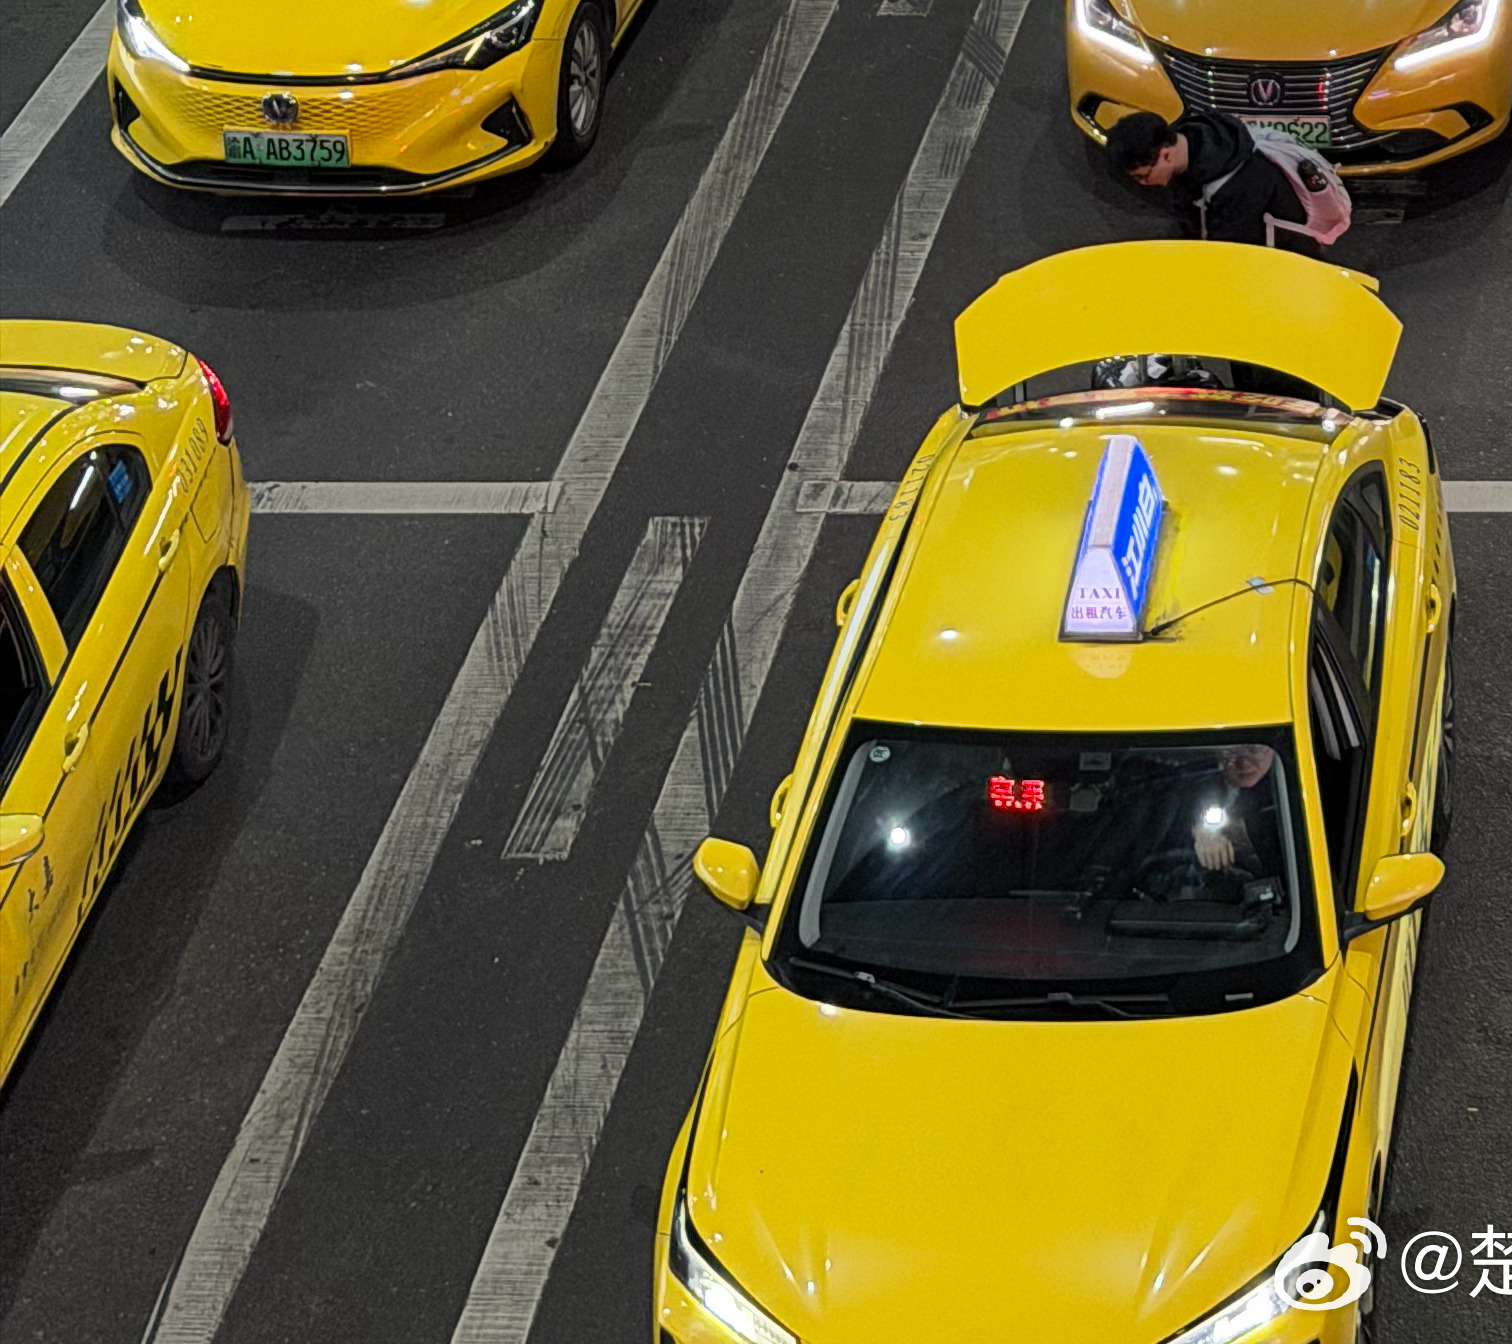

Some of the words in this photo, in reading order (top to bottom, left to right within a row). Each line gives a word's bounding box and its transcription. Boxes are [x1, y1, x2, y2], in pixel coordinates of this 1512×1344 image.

[1247, 120, 1329, 144] 9622
[265, 137, 346, 163] AB3759
[1397, 457, 1421, 531] 021183
[1078, 586, 1121, 600] TAXI
[1071, 605, 1128, 620] 出租汽车
